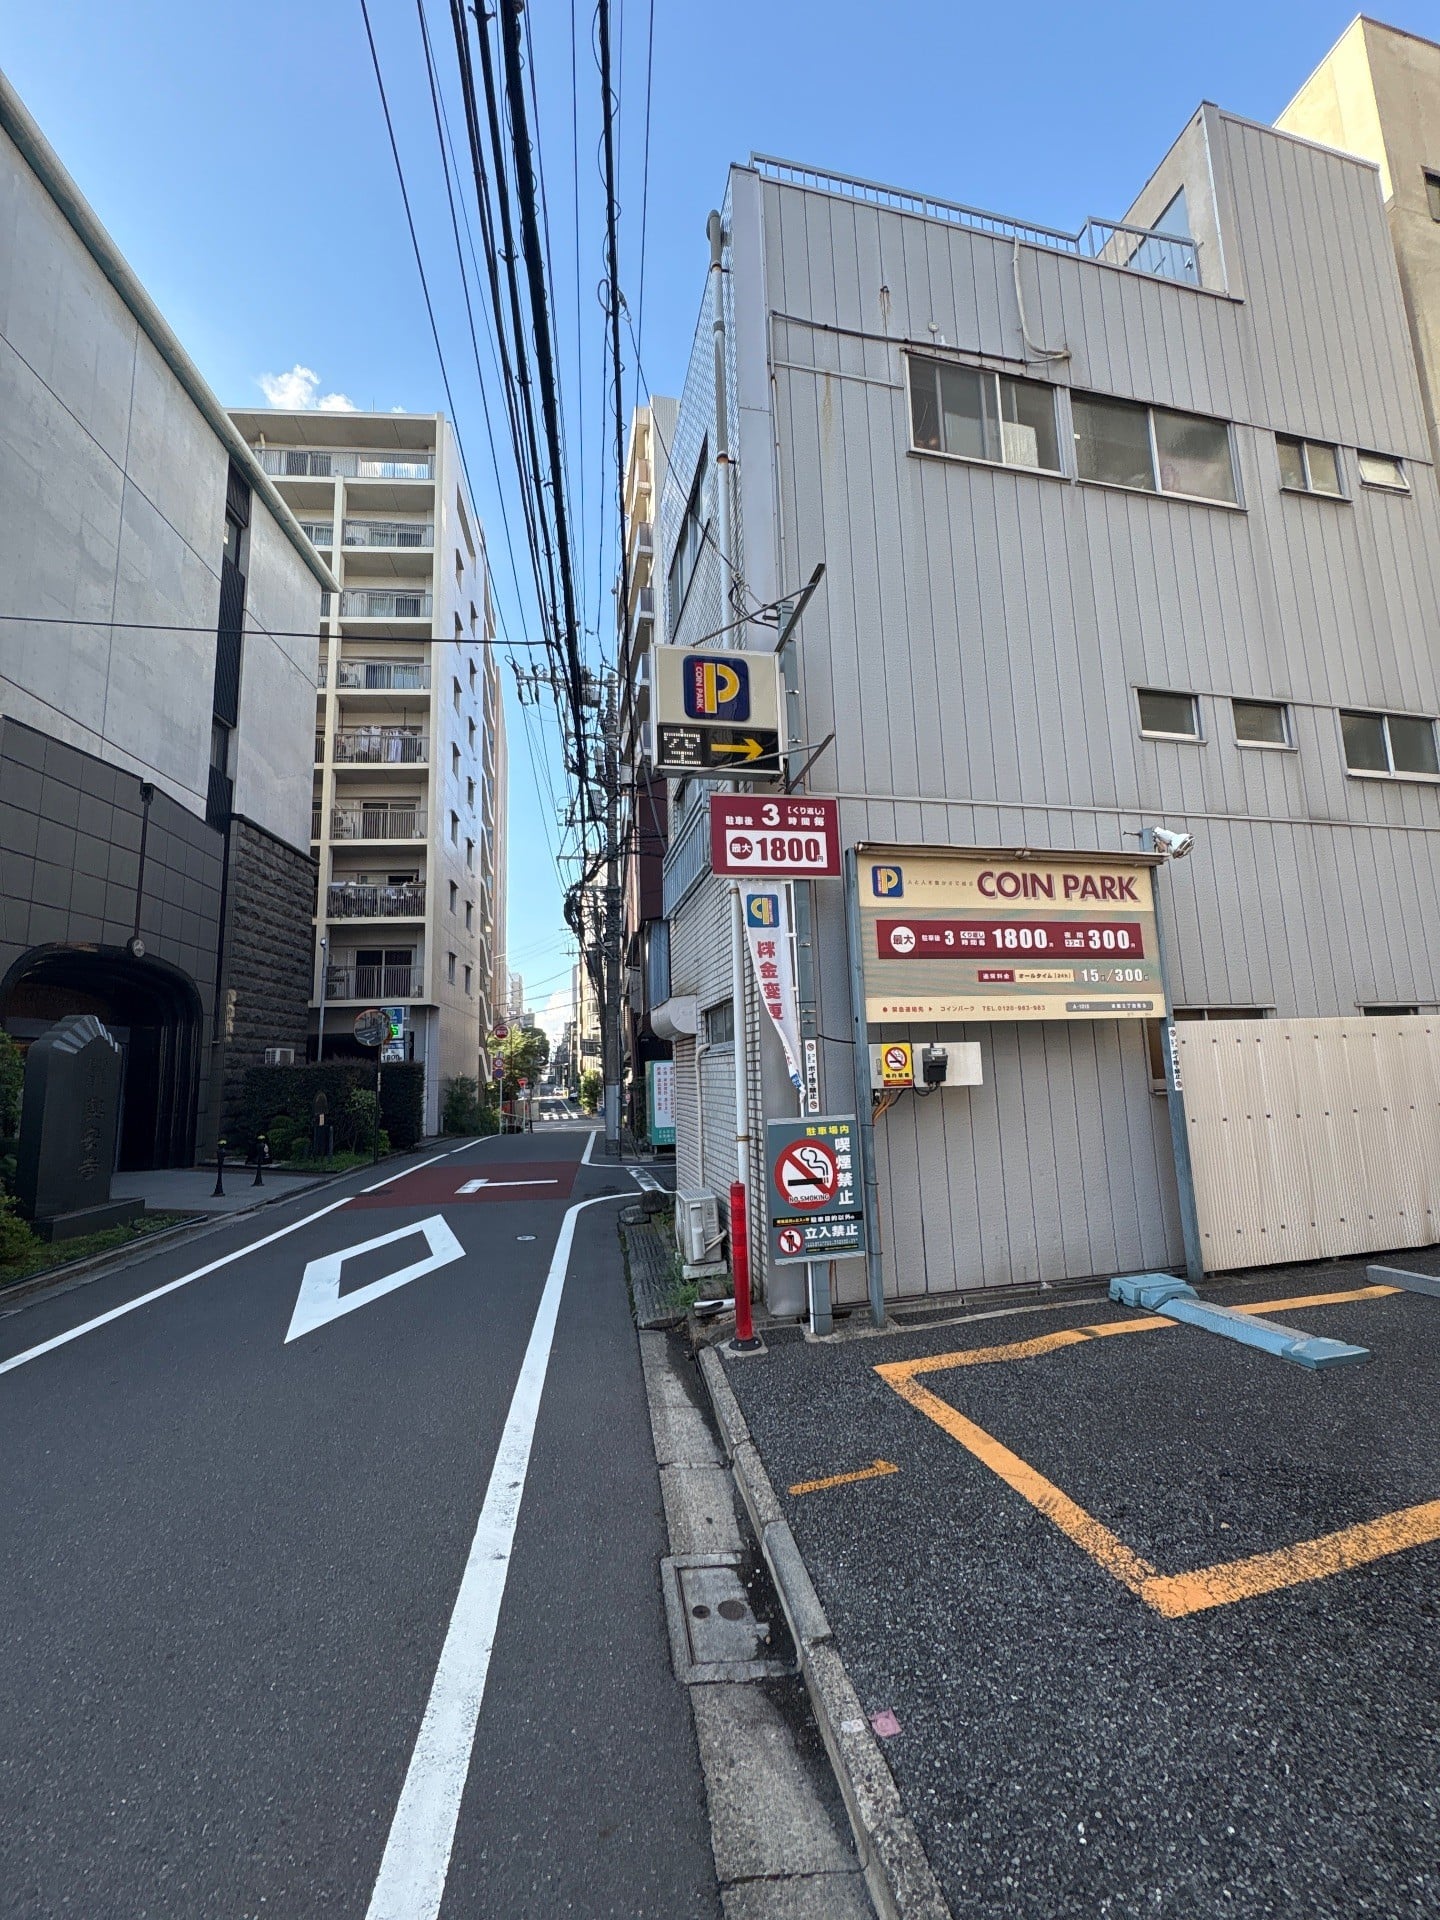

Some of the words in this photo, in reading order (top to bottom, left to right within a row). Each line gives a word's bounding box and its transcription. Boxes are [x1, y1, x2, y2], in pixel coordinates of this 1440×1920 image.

[695, 666, 703, 686] COIN
[695, 687, 704, 709] PARK
[664, 728, 701, 765] 空
[761, 803, 780, 826] 3
[731, 843, 752, 853] 最大
[977, 871, 1054, 898] COIN
[1063, 874, 1140, 900] PARK
[893, 934, 914, 945] 最大
[944, 930, 955, 946] 3
[806, 1125, 850, 1136] 駐車場内
[834, 1137, 854, 1206] 喫煙禁止
[789, 1196, 798, 1204] NO
[799, 1194, 830, 1203] SMOKING
[804, 1223, 859, 1240] 立入禁止
